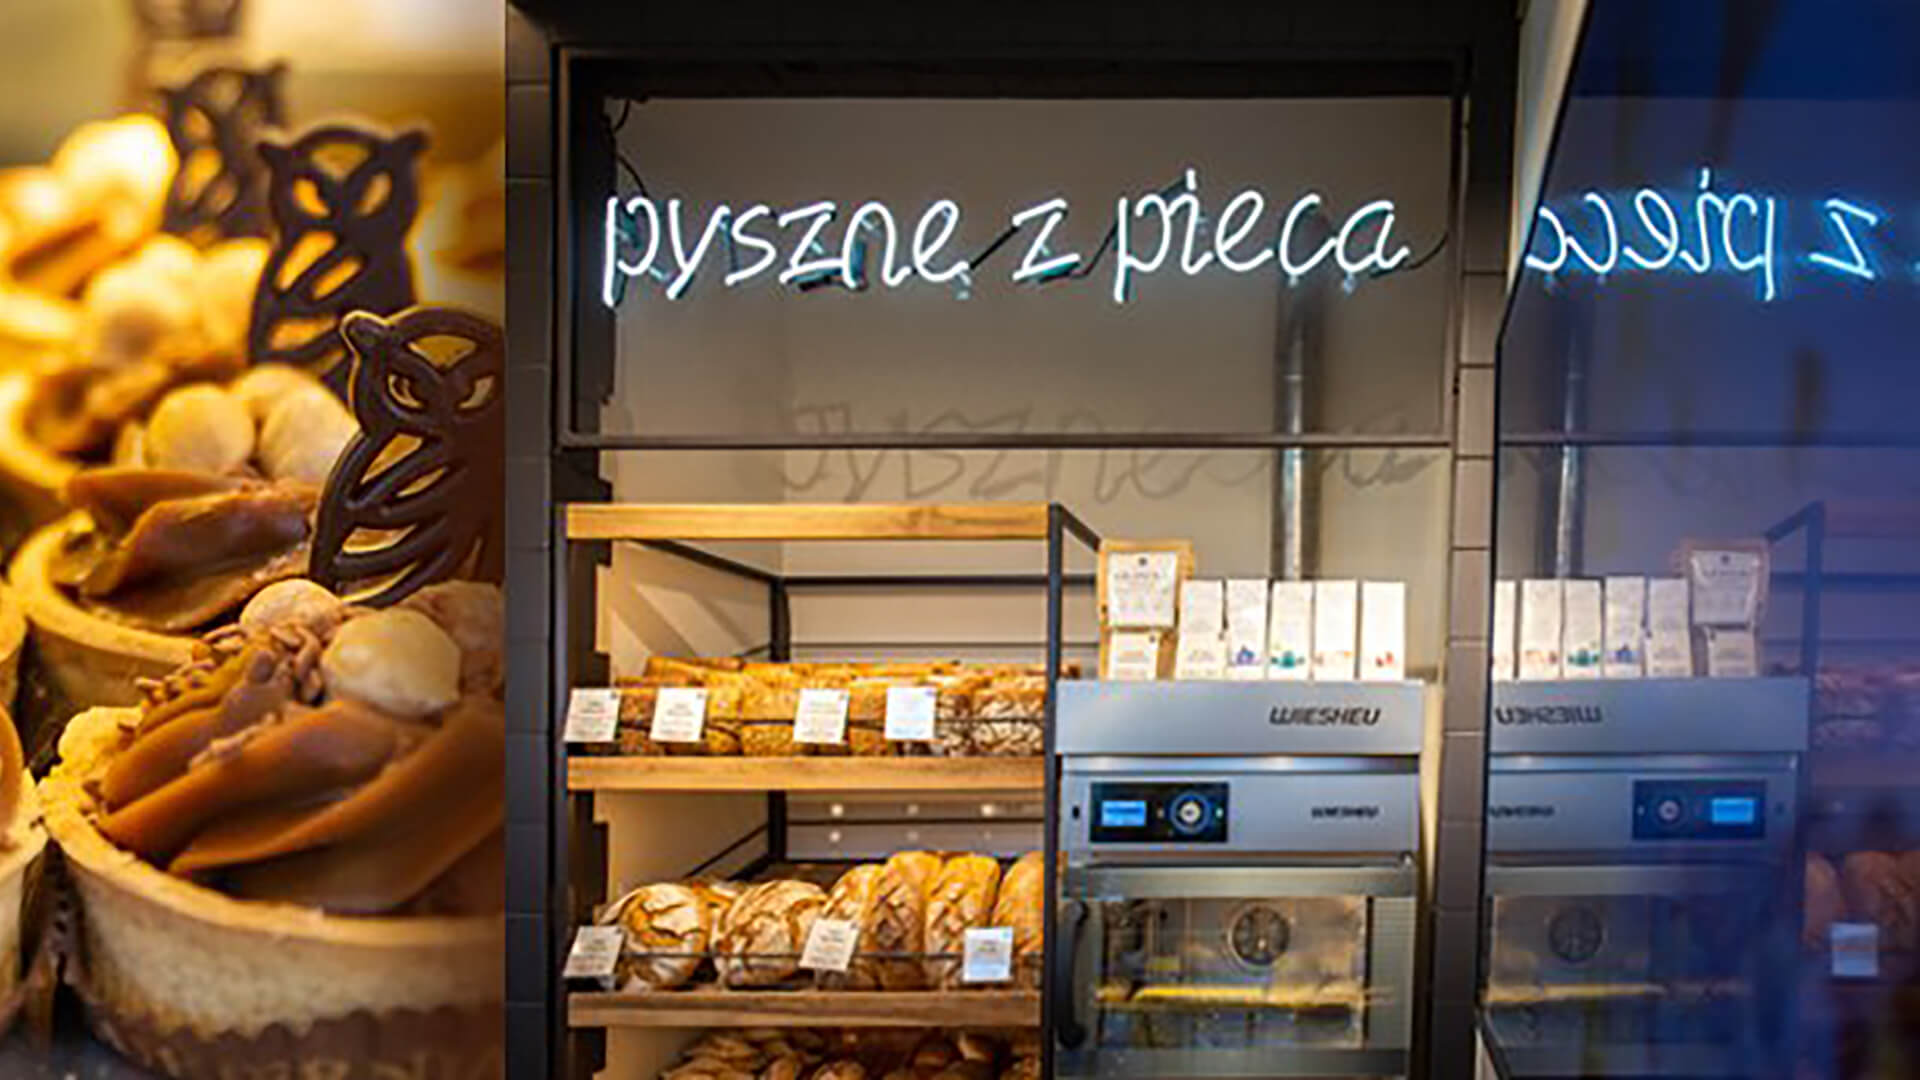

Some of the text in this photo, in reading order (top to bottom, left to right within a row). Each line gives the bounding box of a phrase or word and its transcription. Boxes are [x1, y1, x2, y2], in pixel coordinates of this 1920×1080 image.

[603, 168, 1410, 307] pyszne z pieca
